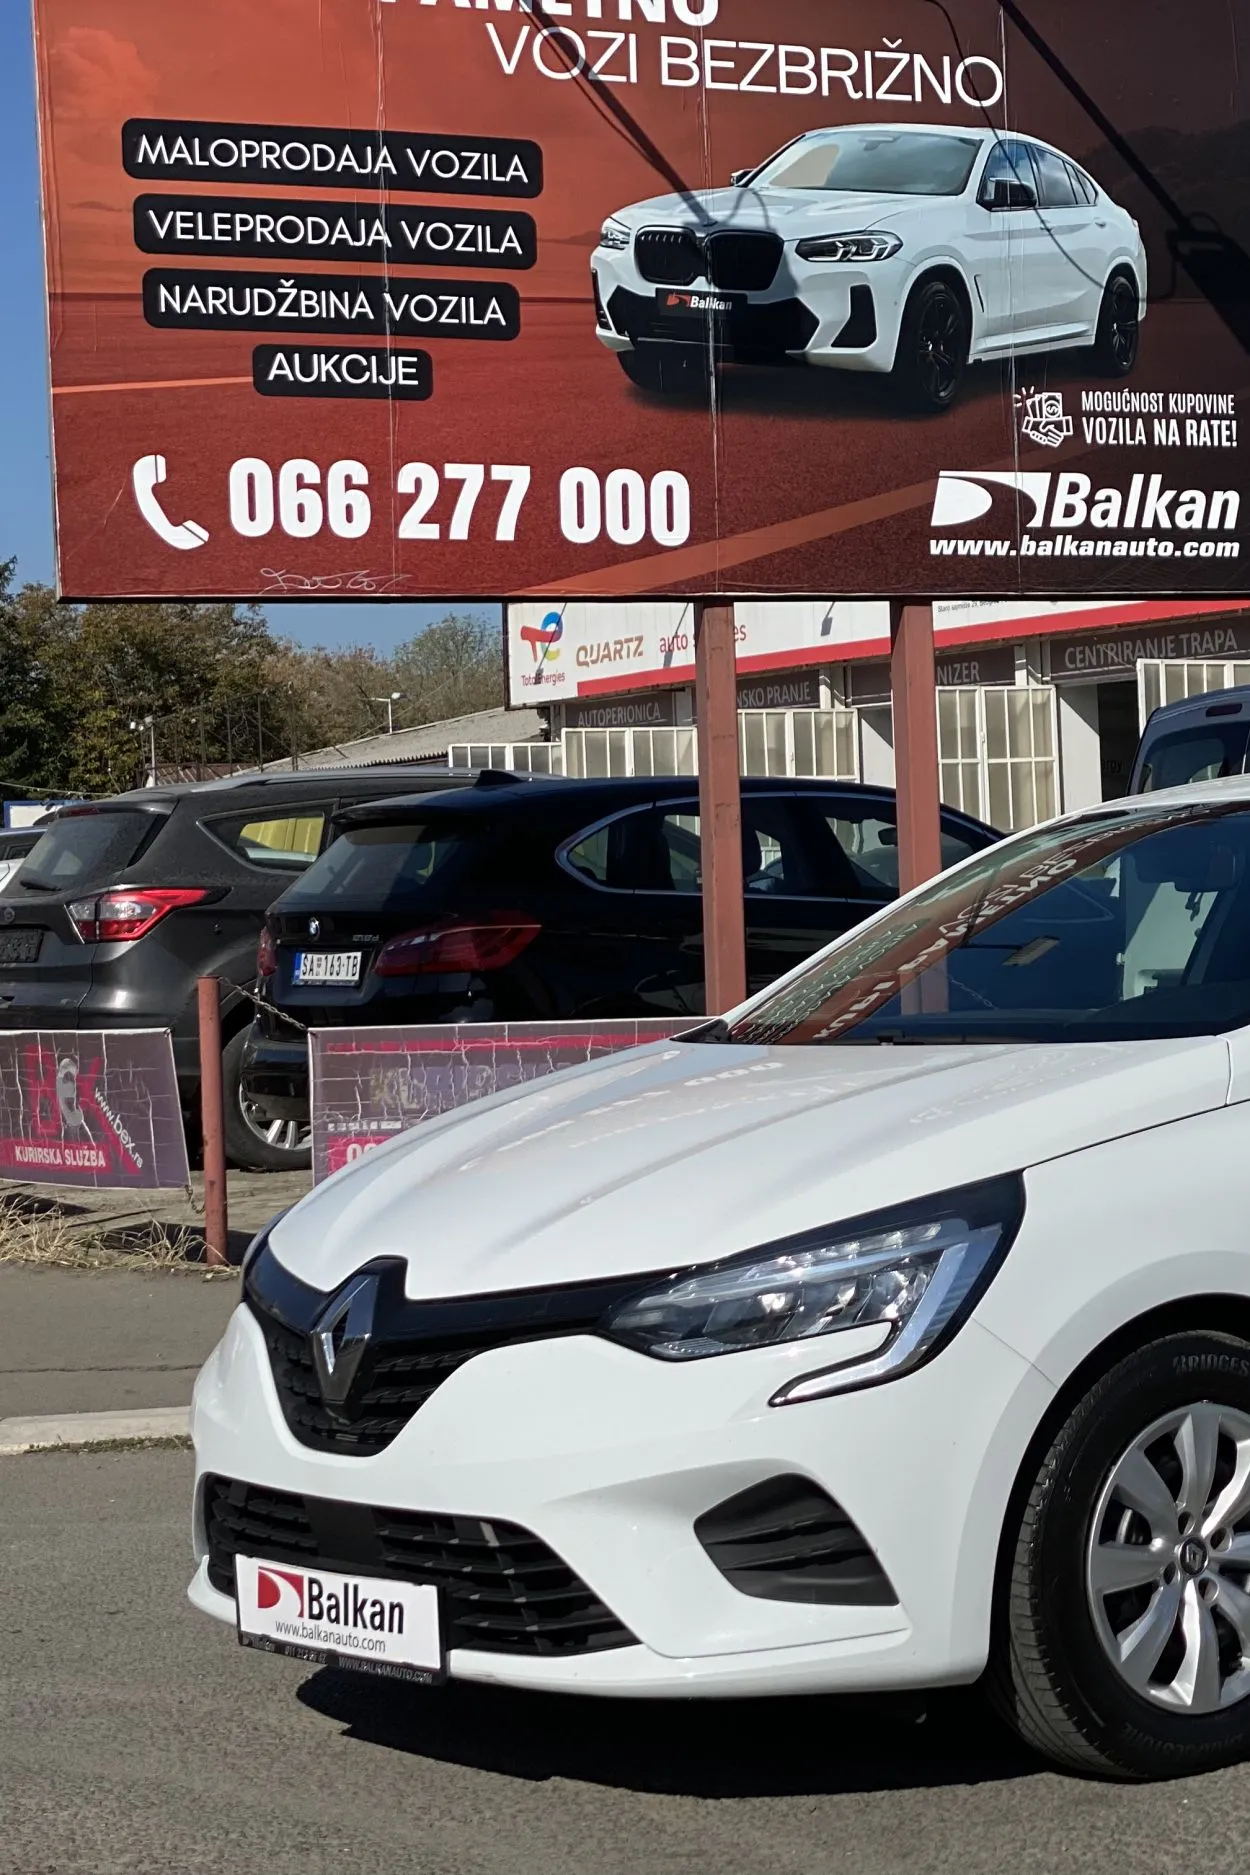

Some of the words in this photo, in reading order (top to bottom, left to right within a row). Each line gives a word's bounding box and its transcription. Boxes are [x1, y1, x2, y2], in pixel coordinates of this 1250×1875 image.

[485, 22, 638, 84] VOZI
[660, 35, 1004, 107] BEZBRIŽNO
[136, 134, 397, 176] MALOPRODAJA
[406, 147, 528, 184] VOZILA
[148, 209, 390, 249] VELEPRODAJA
[400, 219, 523, 256] VOZILA
[158, 278, 375, 321] NARUDŽBINA
[384, 292, 506, 327] VOZILA
[690, 295, 732, 310] Balkan
[267, 351, 419, 386] AUKCIJE
[1081, 388, 1164, 413] MOGUĆNOST
[1168, 394, 1235, 415] KUPOVINE
[1082, 416, 1147, 446] VOZILA
[1153, 419, 1181, 447] NA
[1186, 419, 1238, 448] RATE!
[228, 457, 372, 539] 066
[396, 462, 532, 541] 277
[558, 467, 690, 547] 000
[1049, 471, 1241, 530] Balkan
[929, 534, 1241, 559] www.balkanauto.com
[575, 635, 645, 668] QUARTZ
[659, 632, 689, 654] auto
[1065, 636, 1176, 670] CENTRIRANJE
[1180, 627, 1239, 654] TRAPA
[766, 679, 812, 705] PRANJE
[577, 702, 661, 727] AUTOPERIONICA
[15, 1145, 63, 1164] KURIRSKA
[64, 1145, 106, 1167] SLUŽBA
[307, 1577, 404, 1634] Balkan
[275, 1620, 386, 1653] www.balkanauto.com
